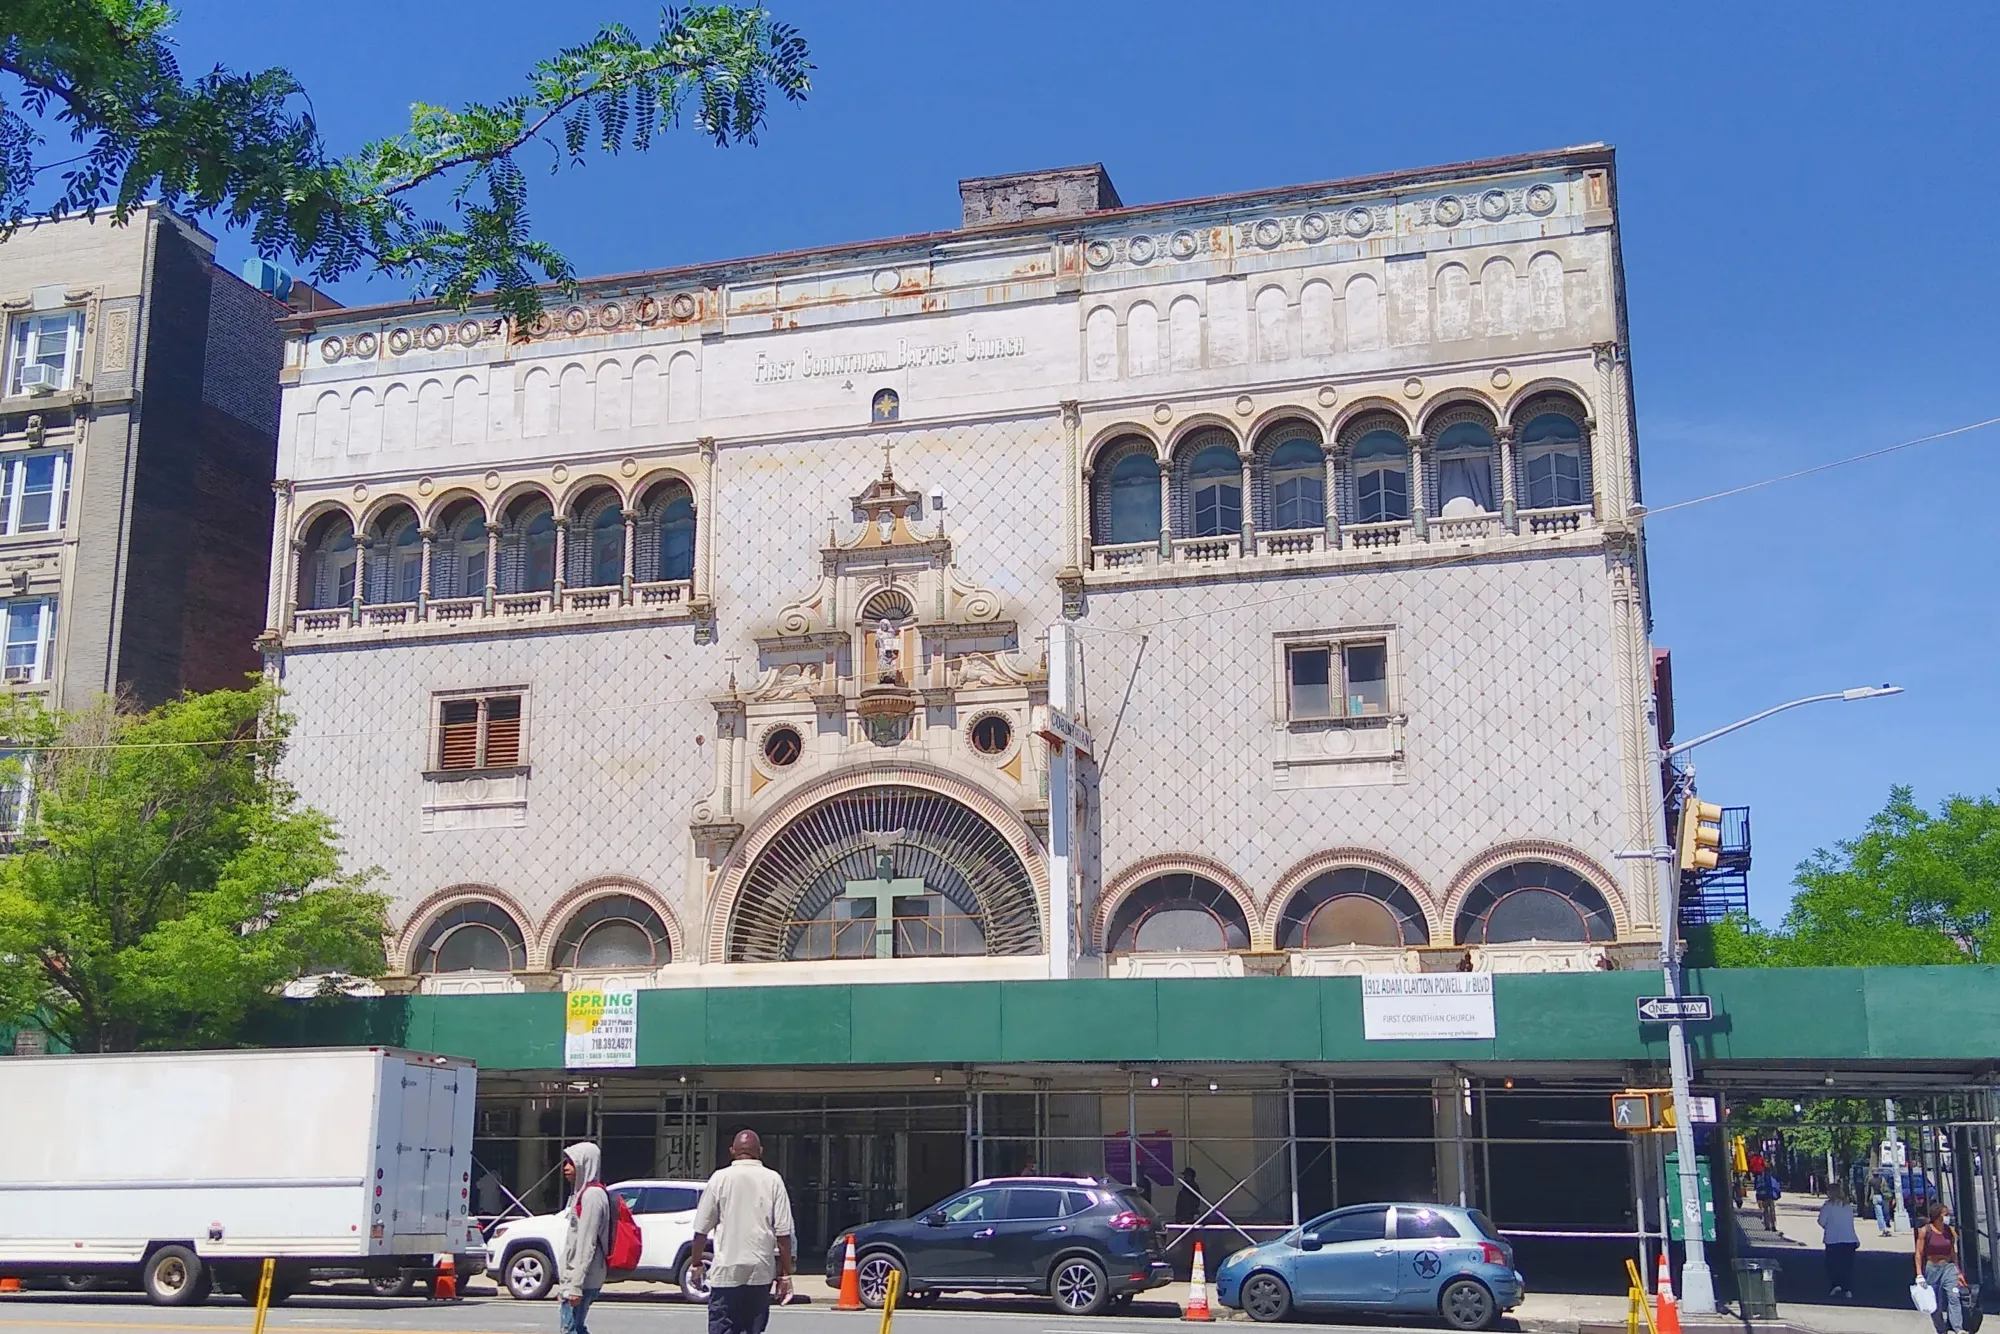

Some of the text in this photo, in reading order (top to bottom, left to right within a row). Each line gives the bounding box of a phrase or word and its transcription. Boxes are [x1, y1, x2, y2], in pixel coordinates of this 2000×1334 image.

[1364, 978, 1380, 995] 1912
[1382, 978, 1402, 995] ADAM
[1403, 978, 1434, 995] CLAYTON
[1435, 977, 1463, 994] POWELL
[1473, 976, 1490, 993] BLVD
[572, 994, 633, 1008] SPRING
[1648, 1003, 1703, 1013] ONE WAY
[1383, 1013, 1475, 1023] FIRST CORINTHIAN CHURCH
